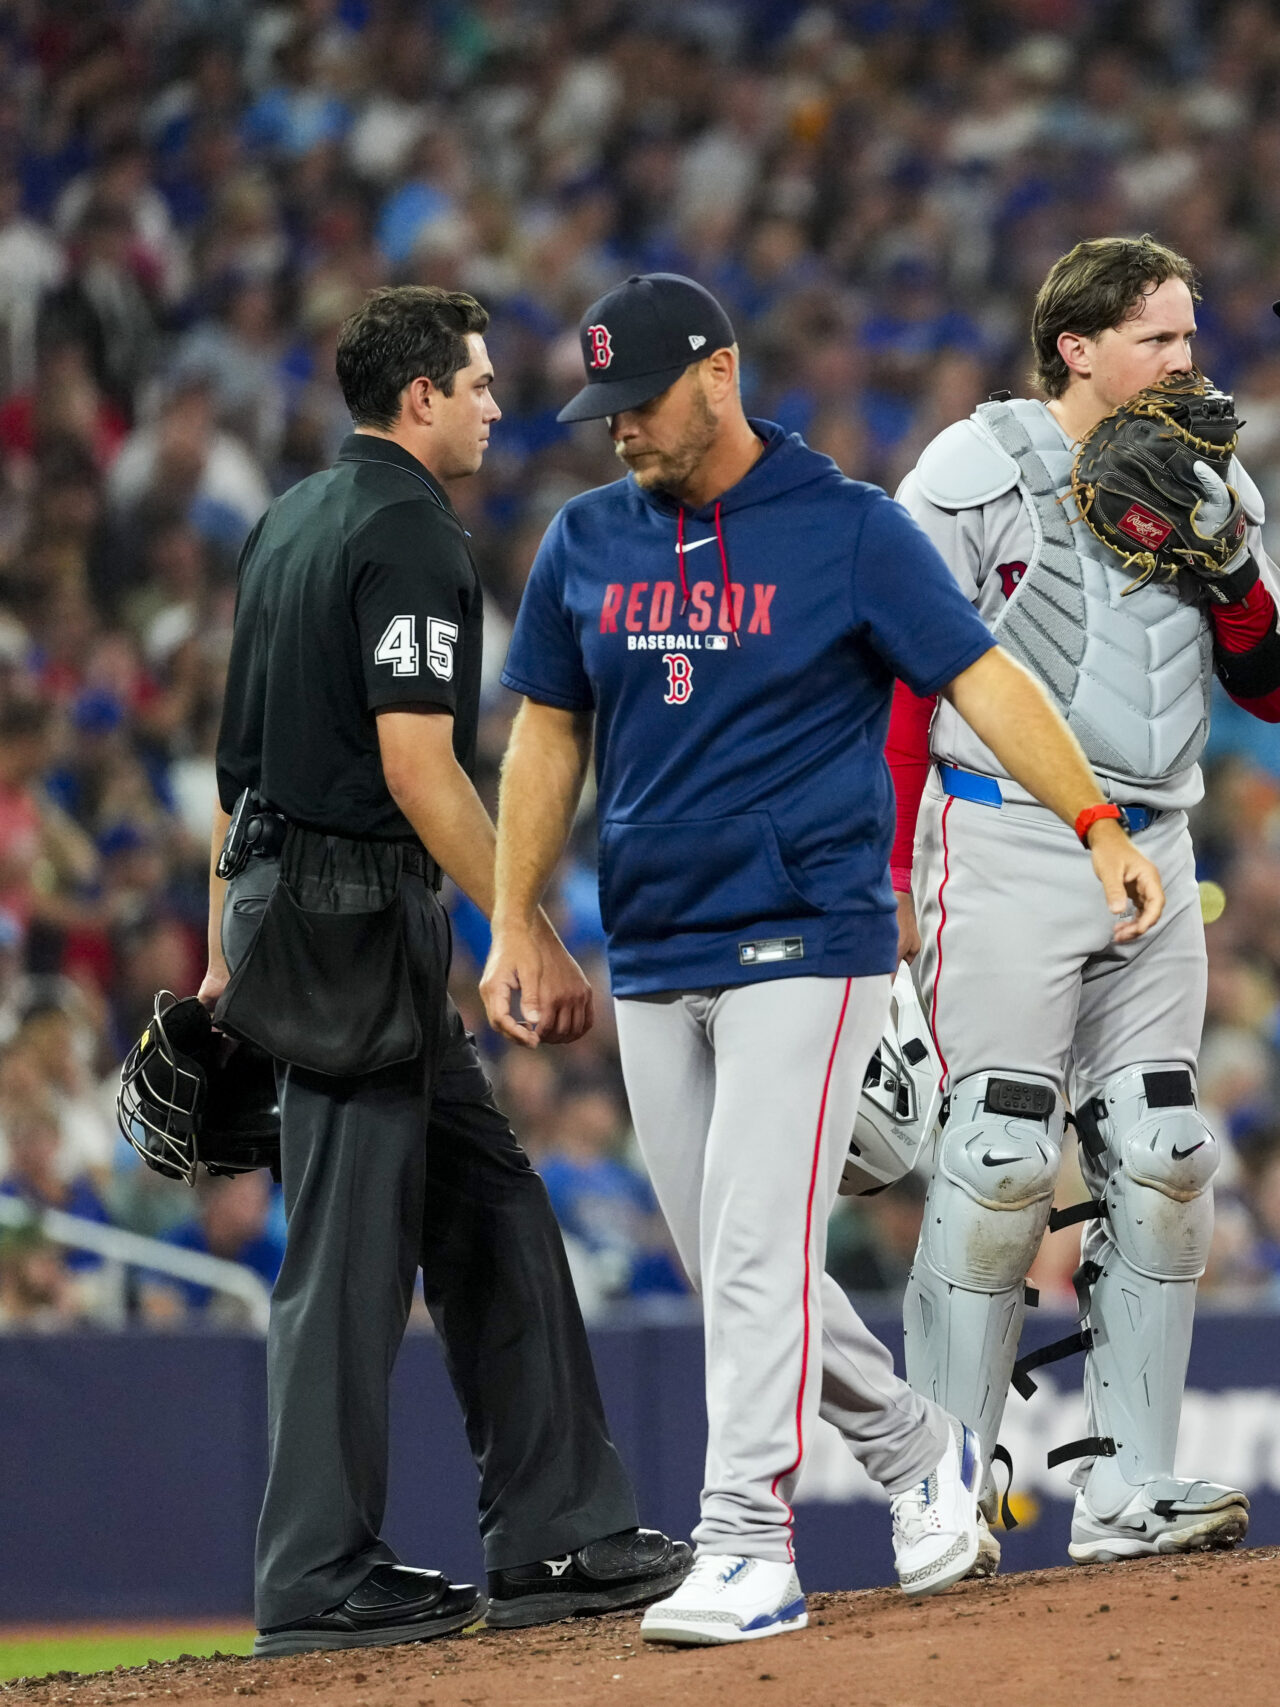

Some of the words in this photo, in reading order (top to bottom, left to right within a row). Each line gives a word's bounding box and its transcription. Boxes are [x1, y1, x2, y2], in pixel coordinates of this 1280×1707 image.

[587, 324, 614, 370] B
[1126, 514, 1163, 537] Rawlings
[599, 581, 675, 634] RED
[688, 581, 777, 635] SOX
[374, 614, 459, 682] 45
[627, 634, 702, 651] BASEBALL
[662, 653, 694, 705] B
